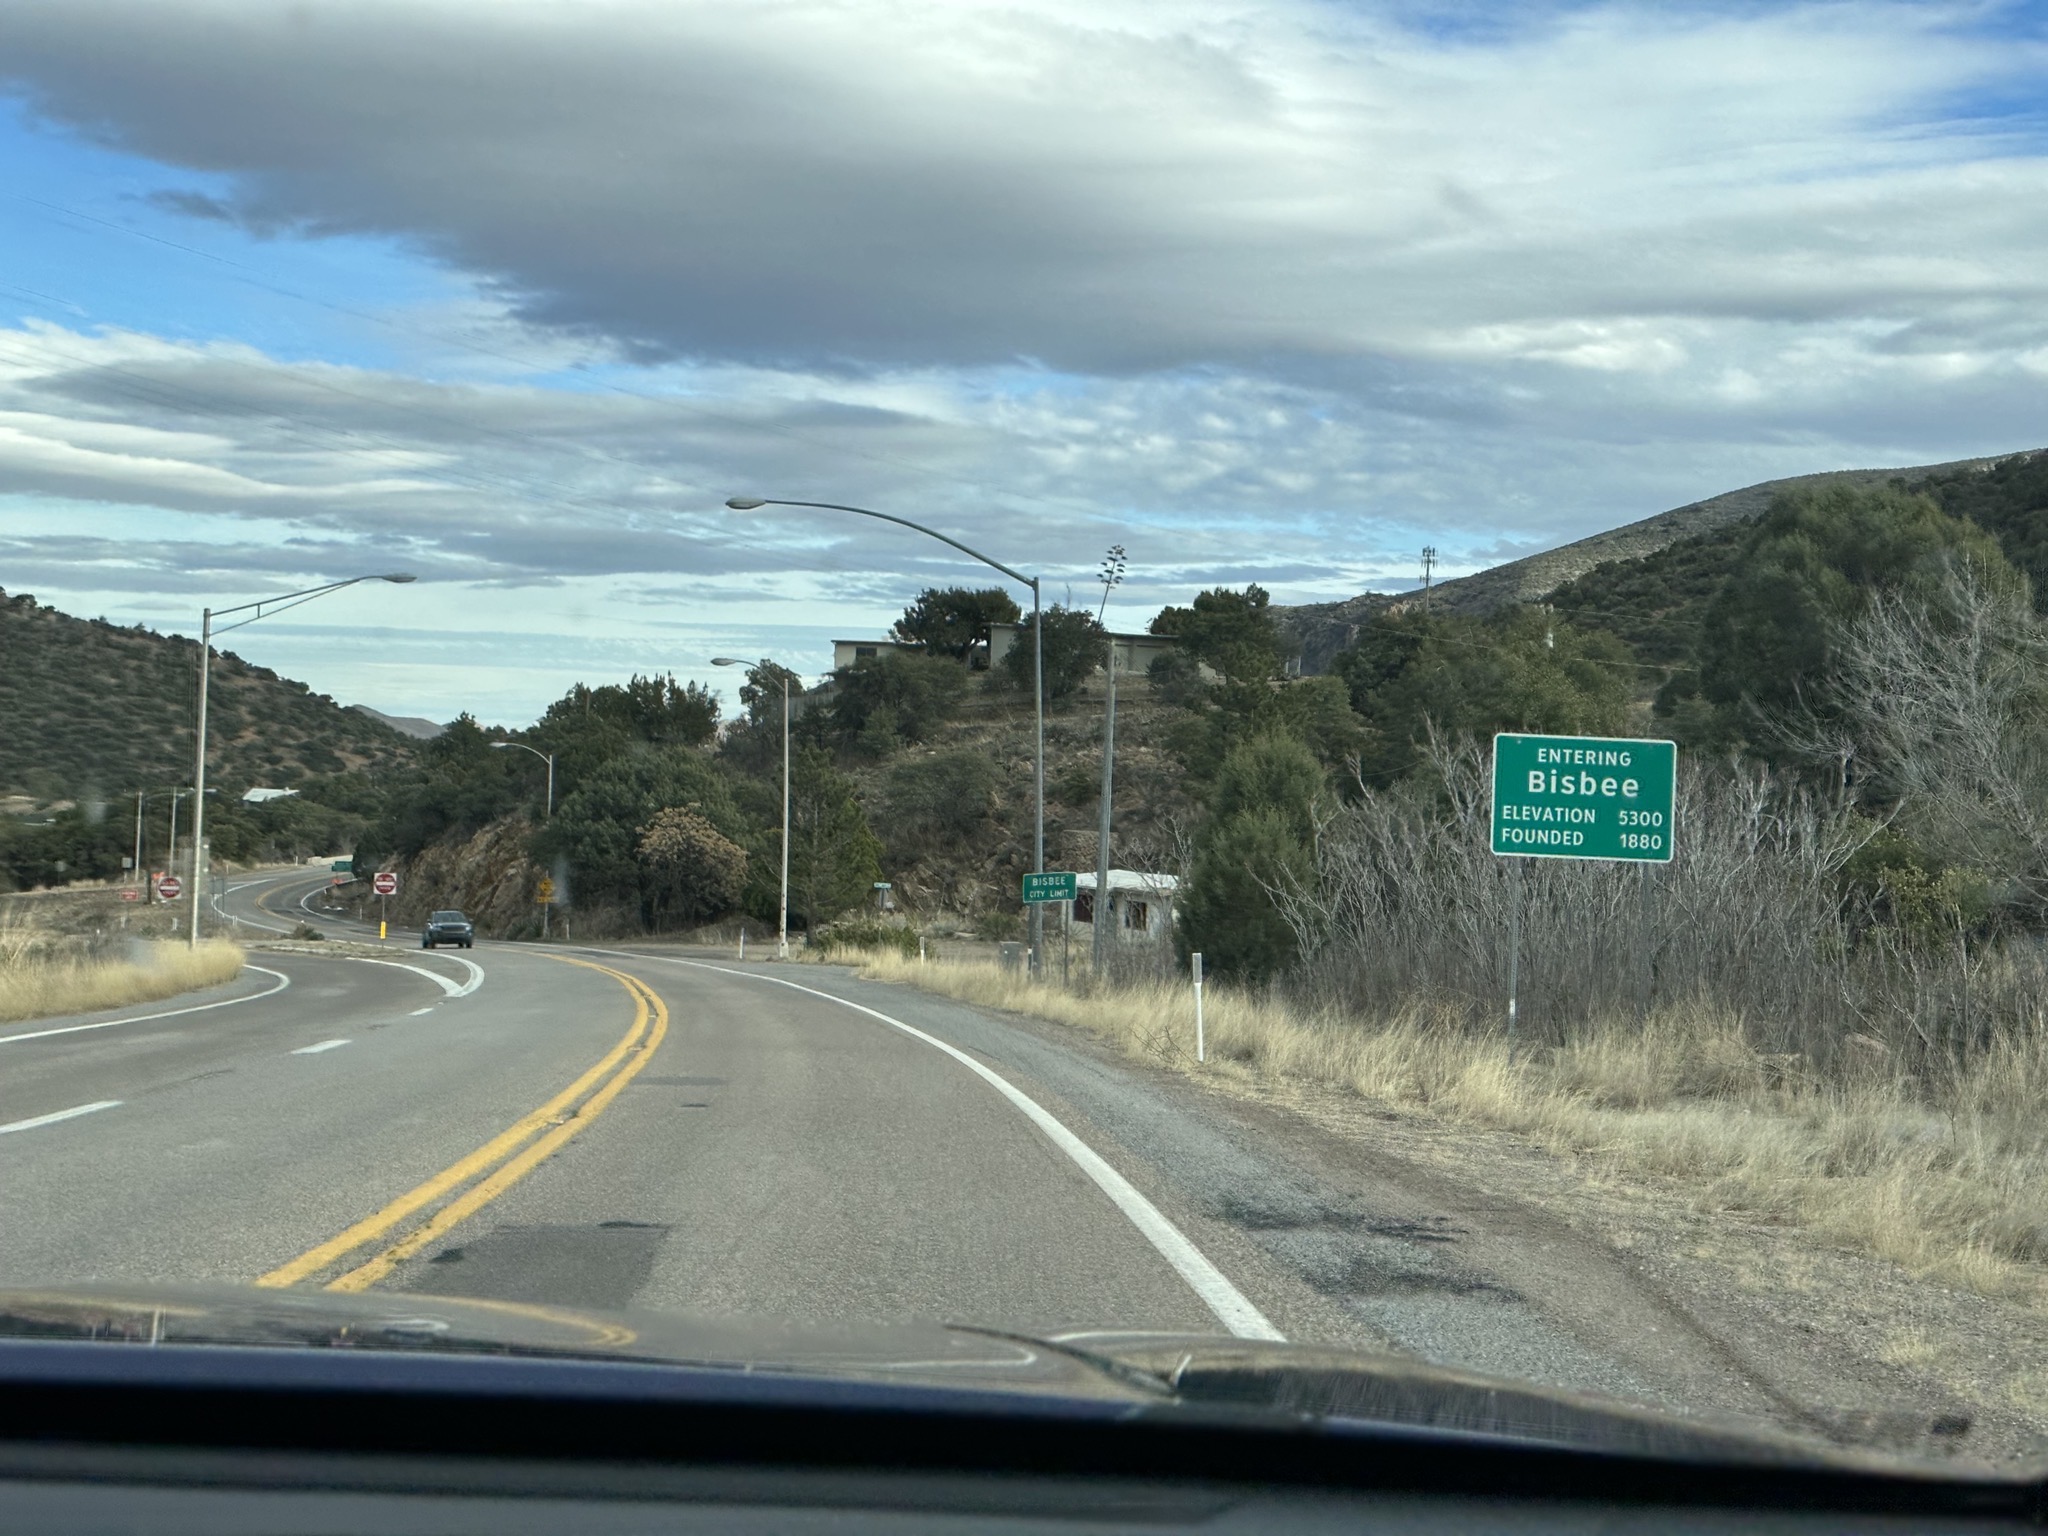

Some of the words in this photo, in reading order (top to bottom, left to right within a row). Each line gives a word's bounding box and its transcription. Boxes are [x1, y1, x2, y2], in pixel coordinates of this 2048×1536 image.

[1538, 748, 1632, 767] ENTERING
[1528, 769, 1639, 798] Bisbee
[1502, 805, 1596, 824] ELEVATION
[1618, 810, 1663, 827] 5300
[1502, 828, 1584, 846] FOUNDED
[1619, 833, 1662, 850] 1880
[1032, 876, 1066, 886] BISBEE
[1029, 890, 1046, 898] CITY
[1050, 889, 1069, 898] LIMIT
